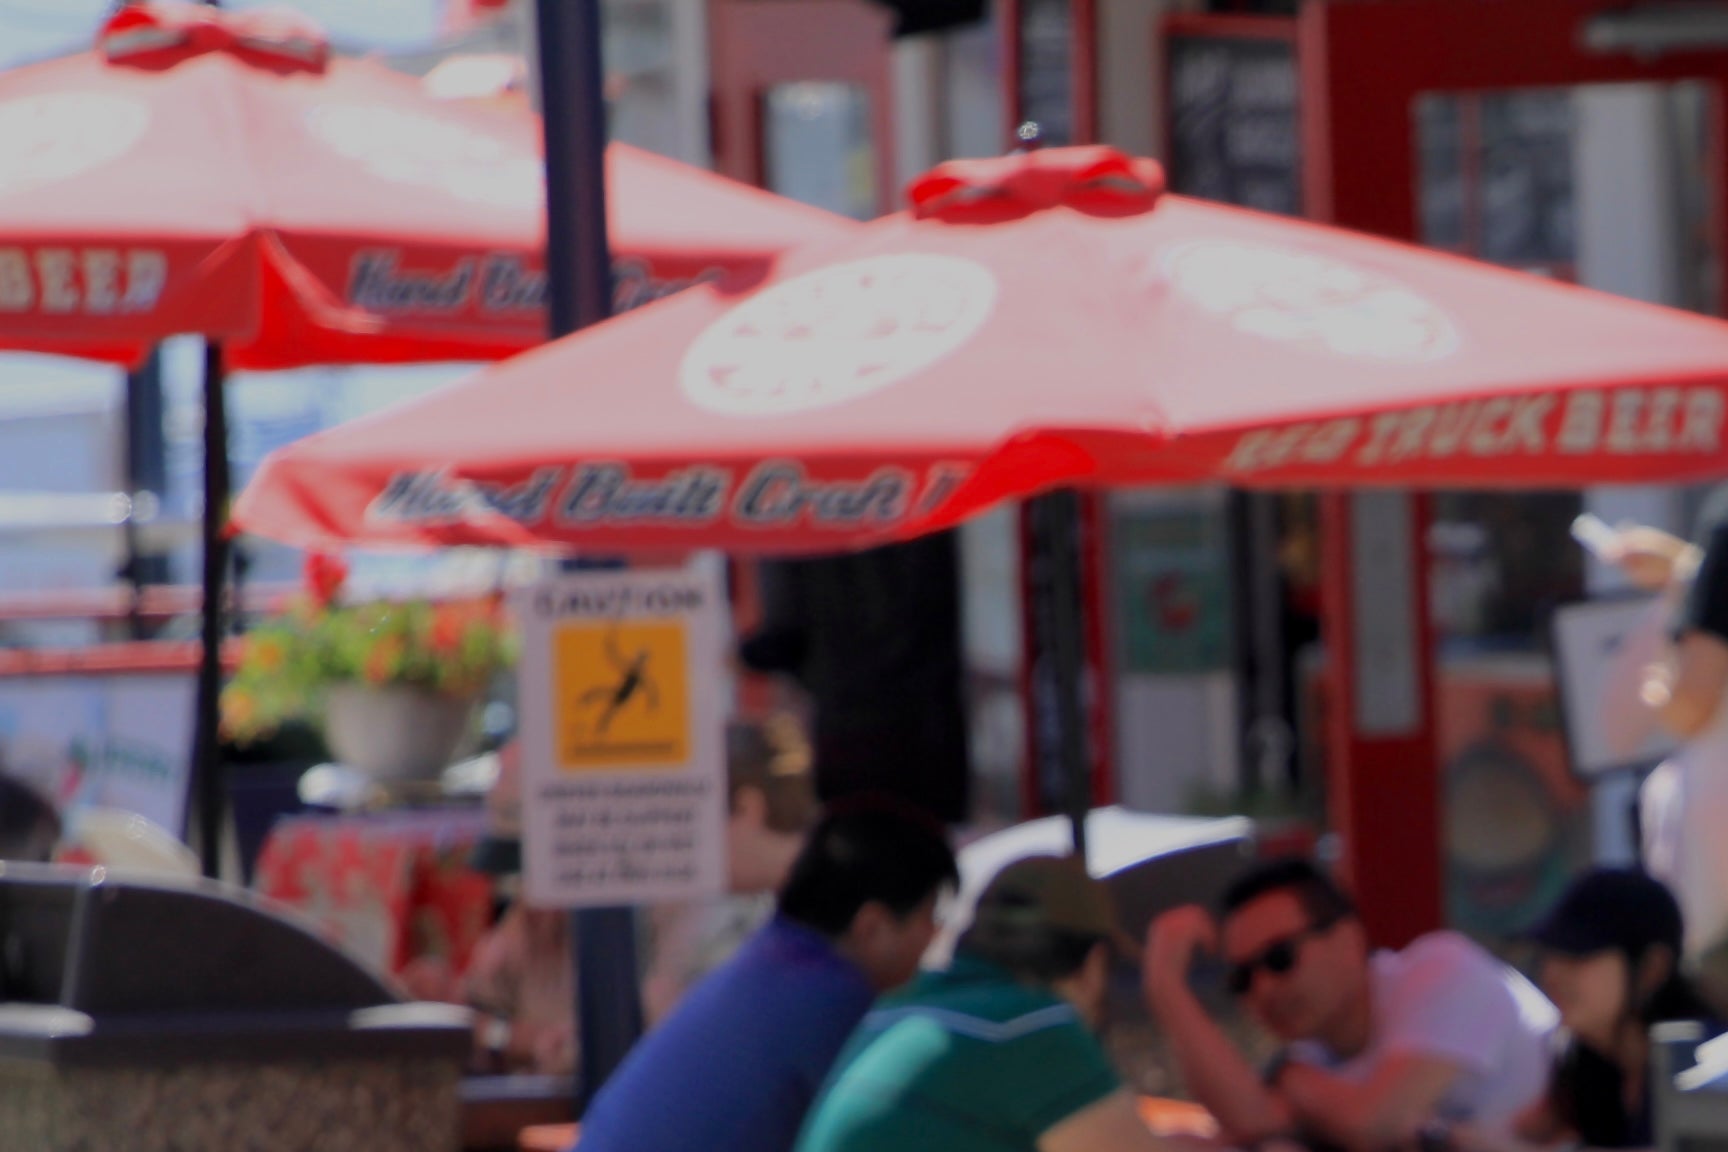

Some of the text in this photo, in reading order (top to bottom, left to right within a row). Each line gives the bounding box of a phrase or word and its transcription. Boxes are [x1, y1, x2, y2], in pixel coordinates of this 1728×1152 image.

[0, 246, 168, 315] BEER
[1355, 392, 1560, 466] TRUCK
[1556, 384, 1727, 456] BEER
[554, 457, 735, 528] Built
[731, 457, 918, 532] Craft
